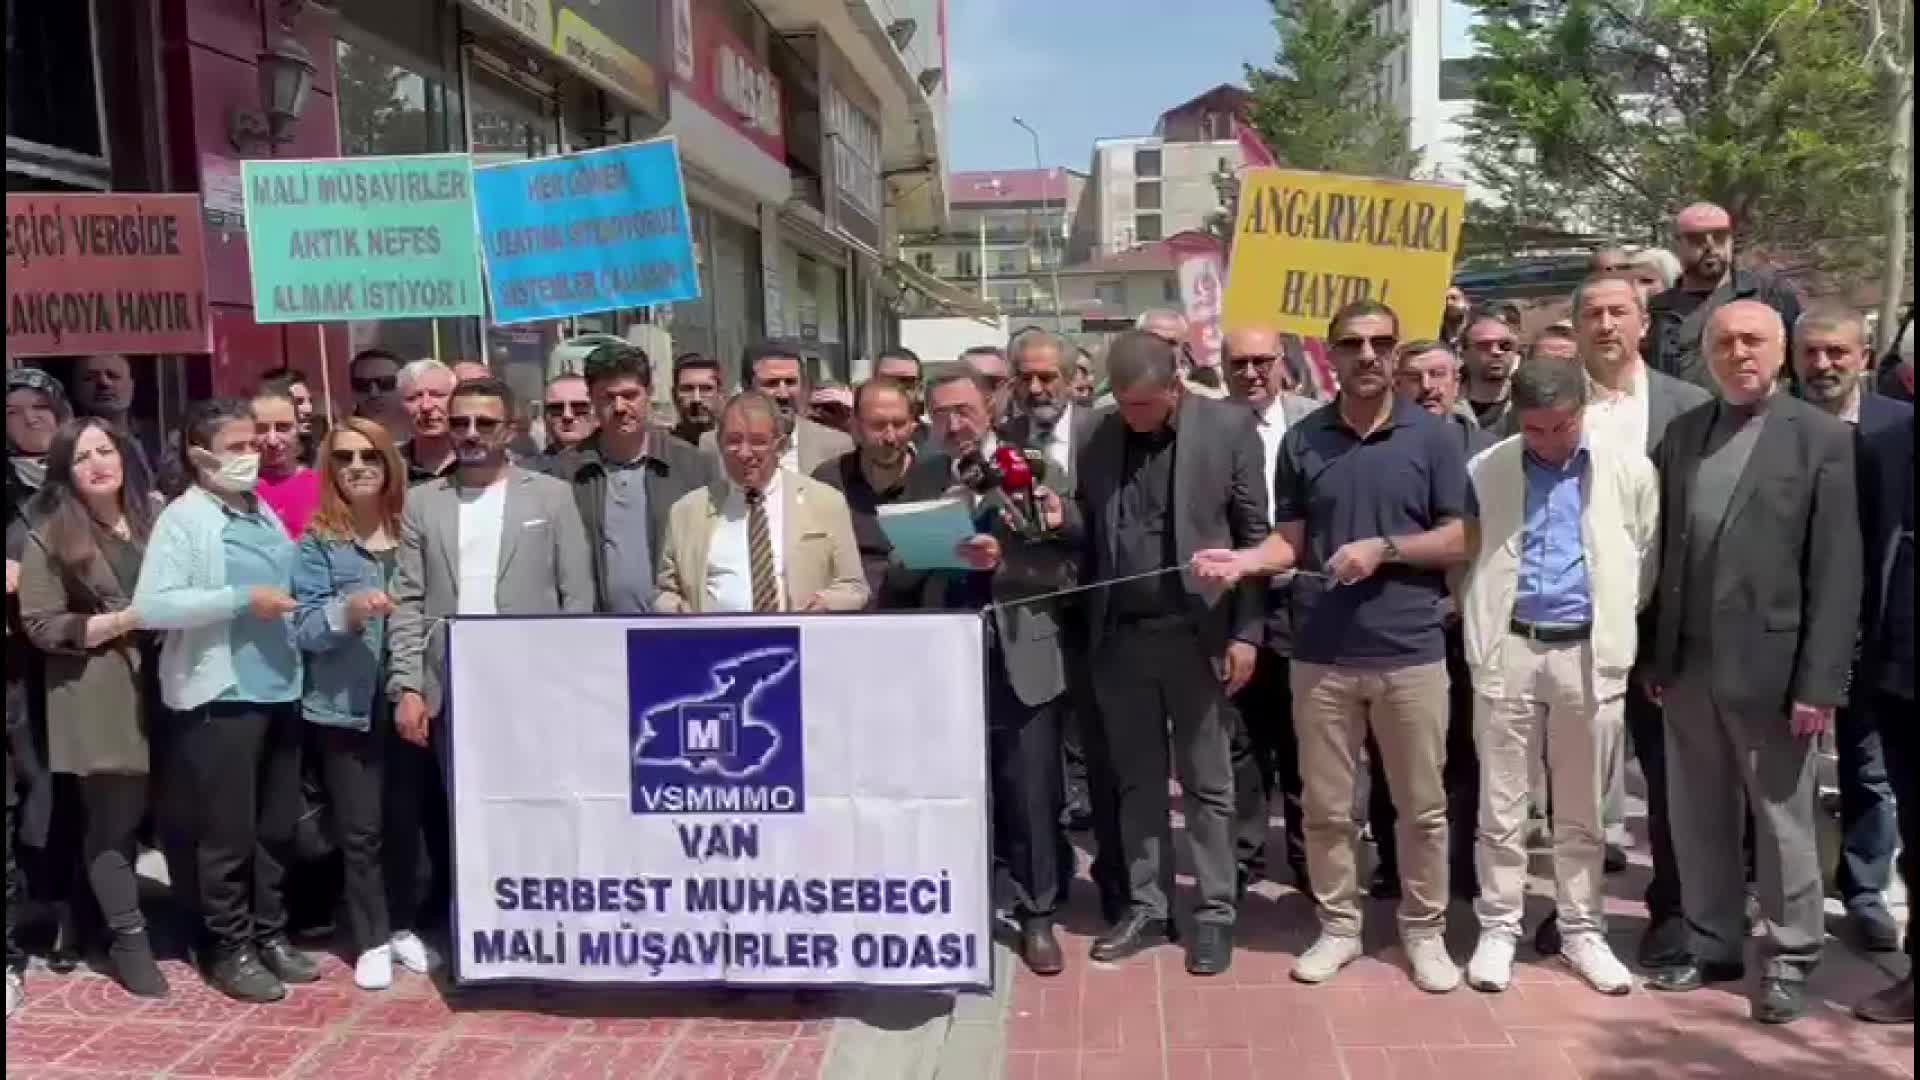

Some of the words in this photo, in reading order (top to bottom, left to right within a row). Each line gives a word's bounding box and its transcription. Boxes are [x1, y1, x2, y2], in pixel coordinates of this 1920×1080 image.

[253, 167, 309, 206] MALİ
[318, 162, 467, 211] MÜŞAVİRLER
[72, 202, 180, 256] VERGİDE
[289, 227, 361, 260] ARTIK
[367, 224, 442, 257] NEFES
[1244, 186, 1449, 253] ANGARYALARA
[273, 280, 353, 315] ALMAK
[361, 271, 454, 311] İSTİYOR
[6, 290, 113, 345] ANÇOYA
[641, 785, 796, 811] VSMMMO
[679, 824, 759, 859] VAN
[494, 877, 672, 913] SERBEST
[684, 869, 952, 915] MUHASEBECİ
[472, 921, 566, 965] MALİ
[578, 922, 839, 977] MÜŞAVİRLER
[851, 932, 977, 968] ODASI
